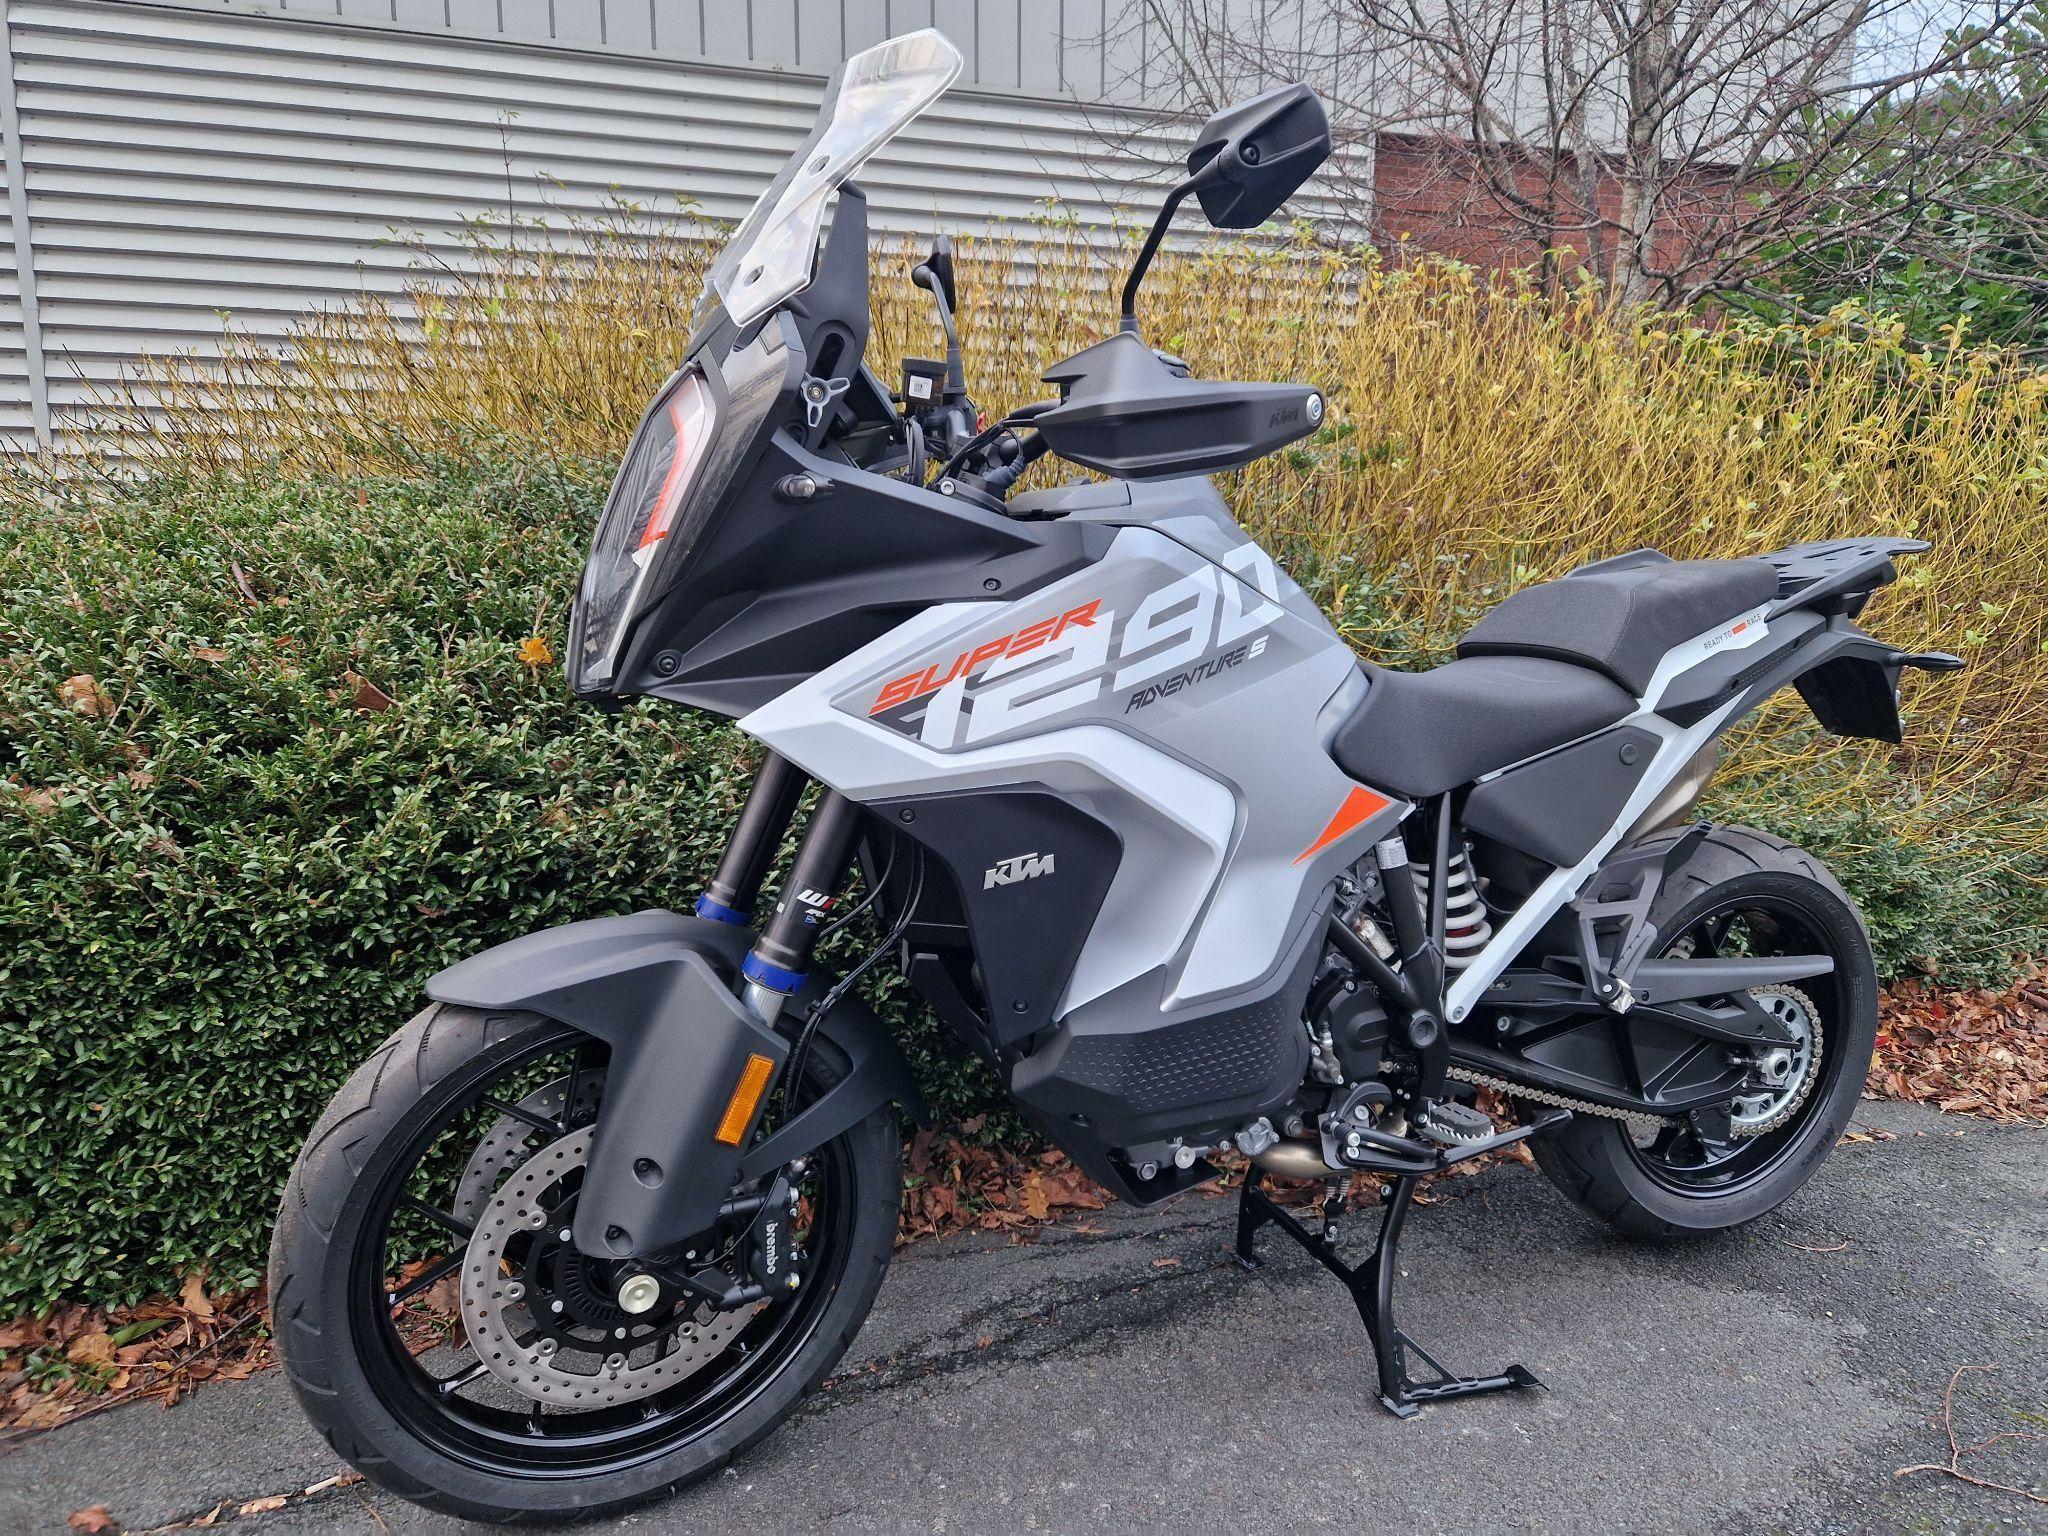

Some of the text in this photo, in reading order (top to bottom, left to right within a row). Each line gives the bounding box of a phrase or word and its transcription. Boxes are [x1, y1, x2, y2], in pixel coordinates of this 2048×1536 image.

[868, 599, 1103, 716] SUPER
[921, 541, 1285, 750] 1290
[1704, 613, 1761, 651] READY TO RACE
[1124, 635, 1269, 715] ADVENTURE S
[983, 852, 1055, 891] KTM
[766, 1222, 779, 1275] brembo
